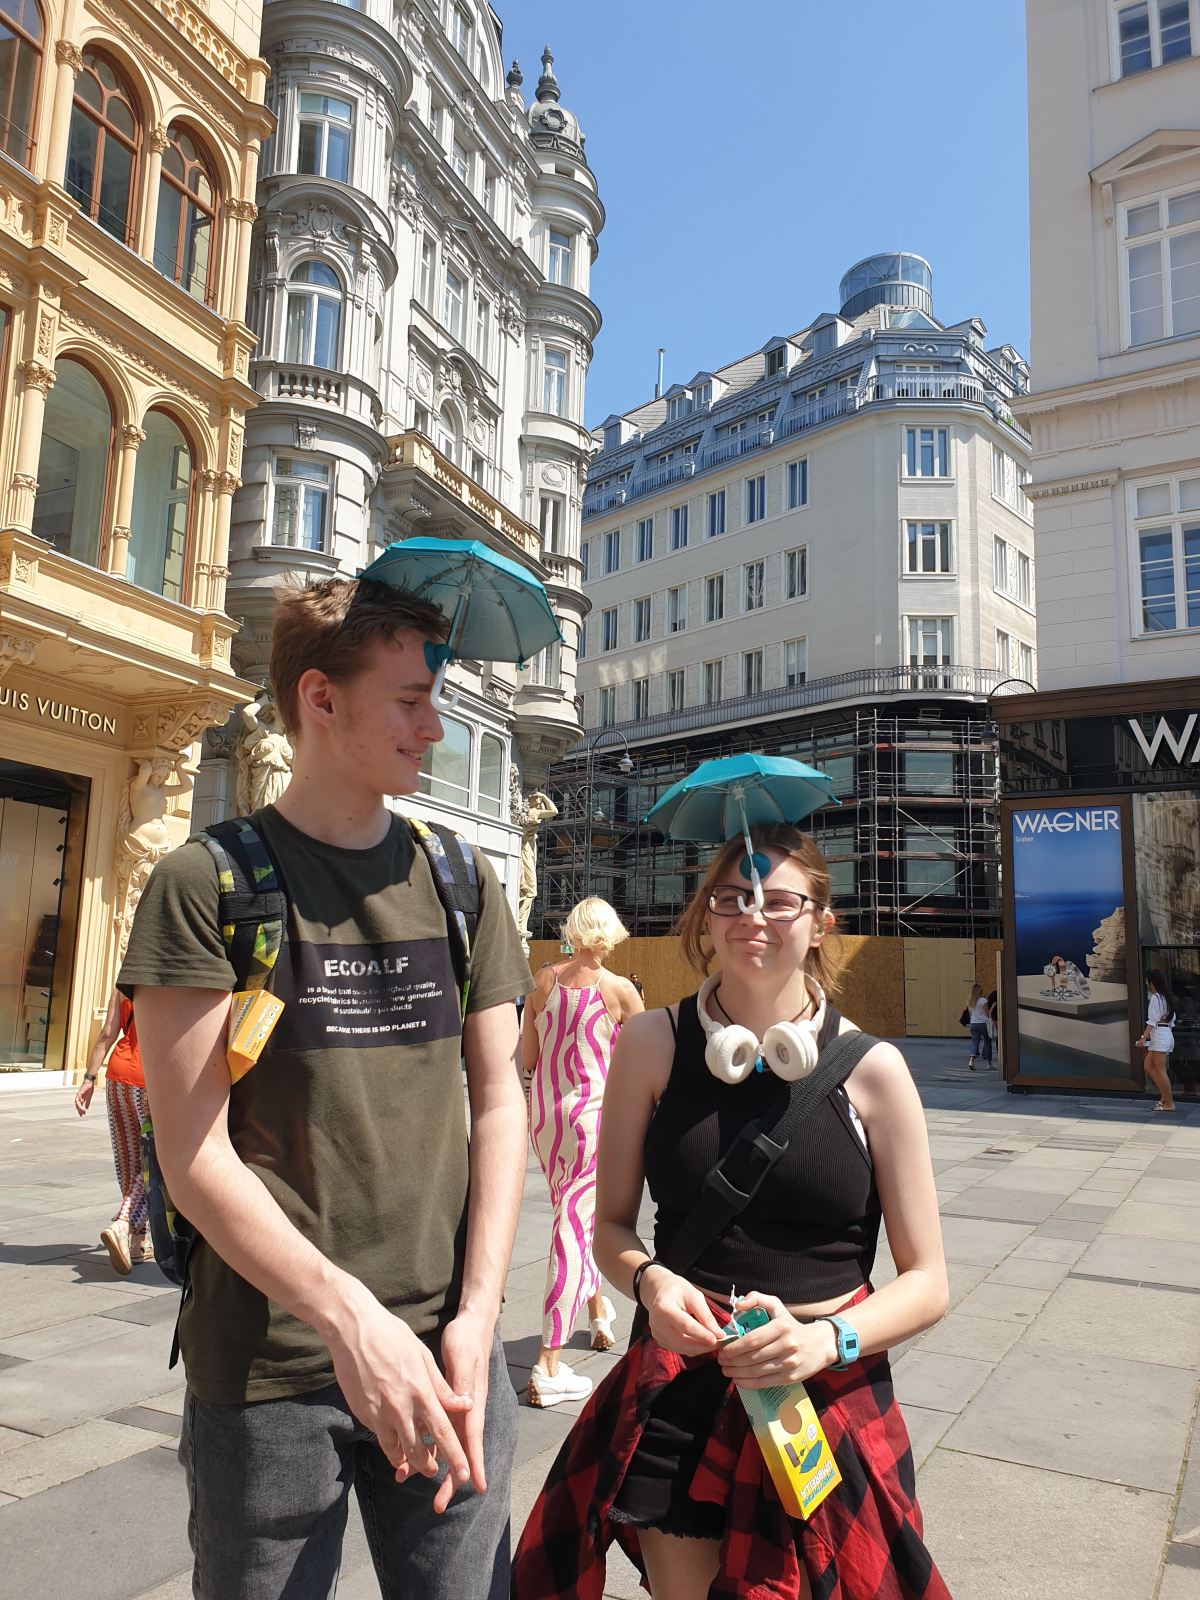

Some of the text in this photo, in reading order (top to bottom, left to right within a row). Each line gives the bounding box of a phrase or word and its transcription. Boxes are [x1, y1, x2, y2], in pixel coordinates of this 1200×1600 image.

[36, 697, 116, 735] VUITTON
[1128, 713, 1200, 766] W
[1014, 809, 1120, 834] WAGNER
[1015, 835, 1034, 843] Graben
[323, 956, 409, 977] ECOALF
[407, 989, 443, 1003] generation
[413, 980, 437, 992] quality
[326, 1025, 351, 1033] BECAUSE
[379, 1024, 391, 1033] NO
[391, 1021, 420, 1031] PLANET
[420, 1019, 427, 1028] B
[799, 1460, 833, 1499] UMBRELLA
[802, 1469, 836, 1508] SMARTPHONE
